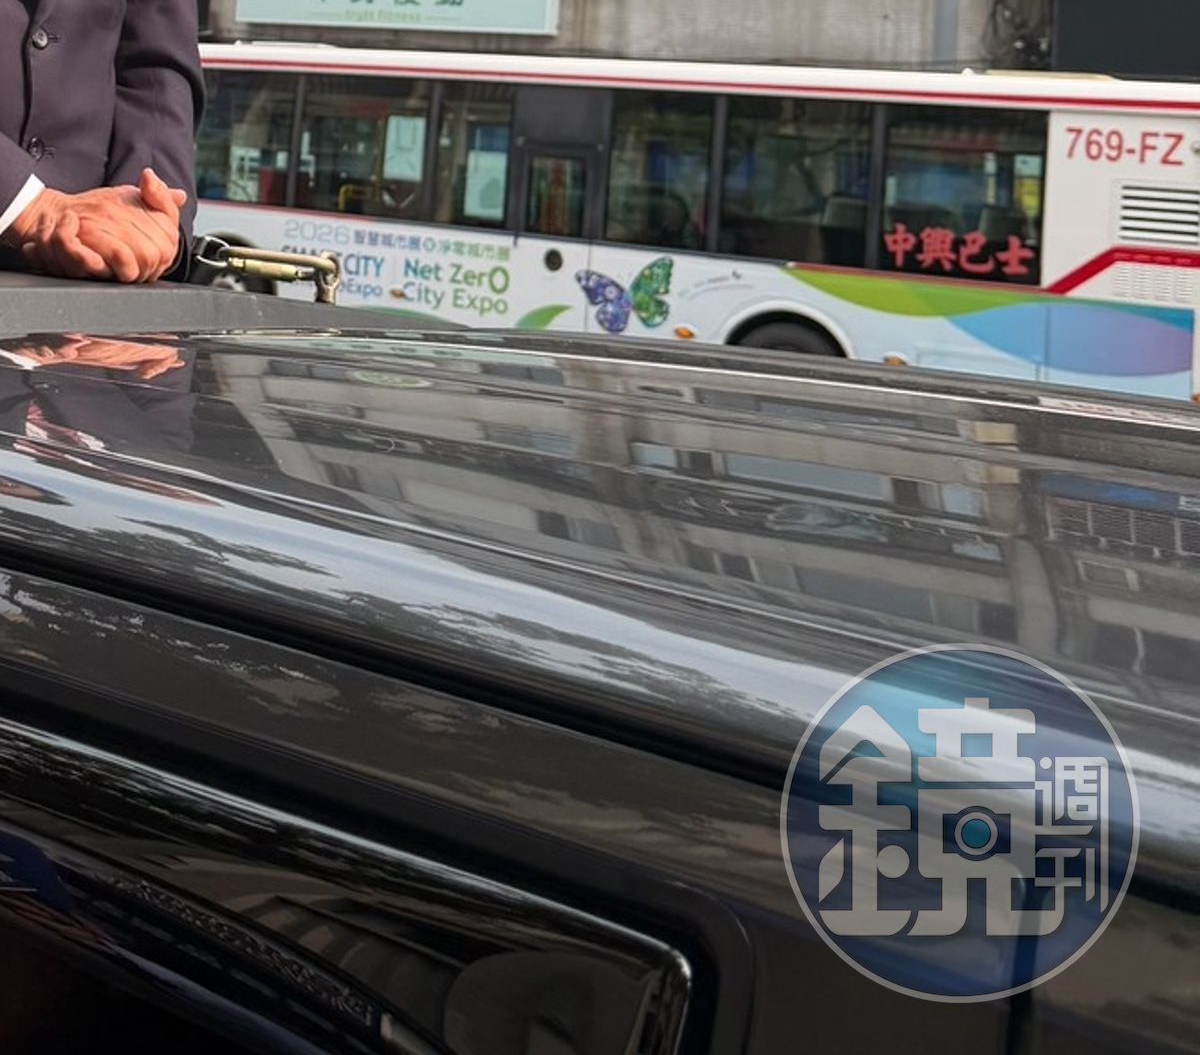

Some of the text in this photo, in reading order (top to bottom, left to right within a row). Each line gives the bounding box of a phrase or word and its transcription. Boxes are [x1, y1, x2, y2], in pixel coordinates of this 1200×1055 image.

[1065, 126, 1184, 166] 769-FZ
[284, 219, 350, 245] 2026
[883, 221, 1035, 276] 中興巴士
[403, 257, 443, 282] Net
[402, 281, 510, 317] City Expo
